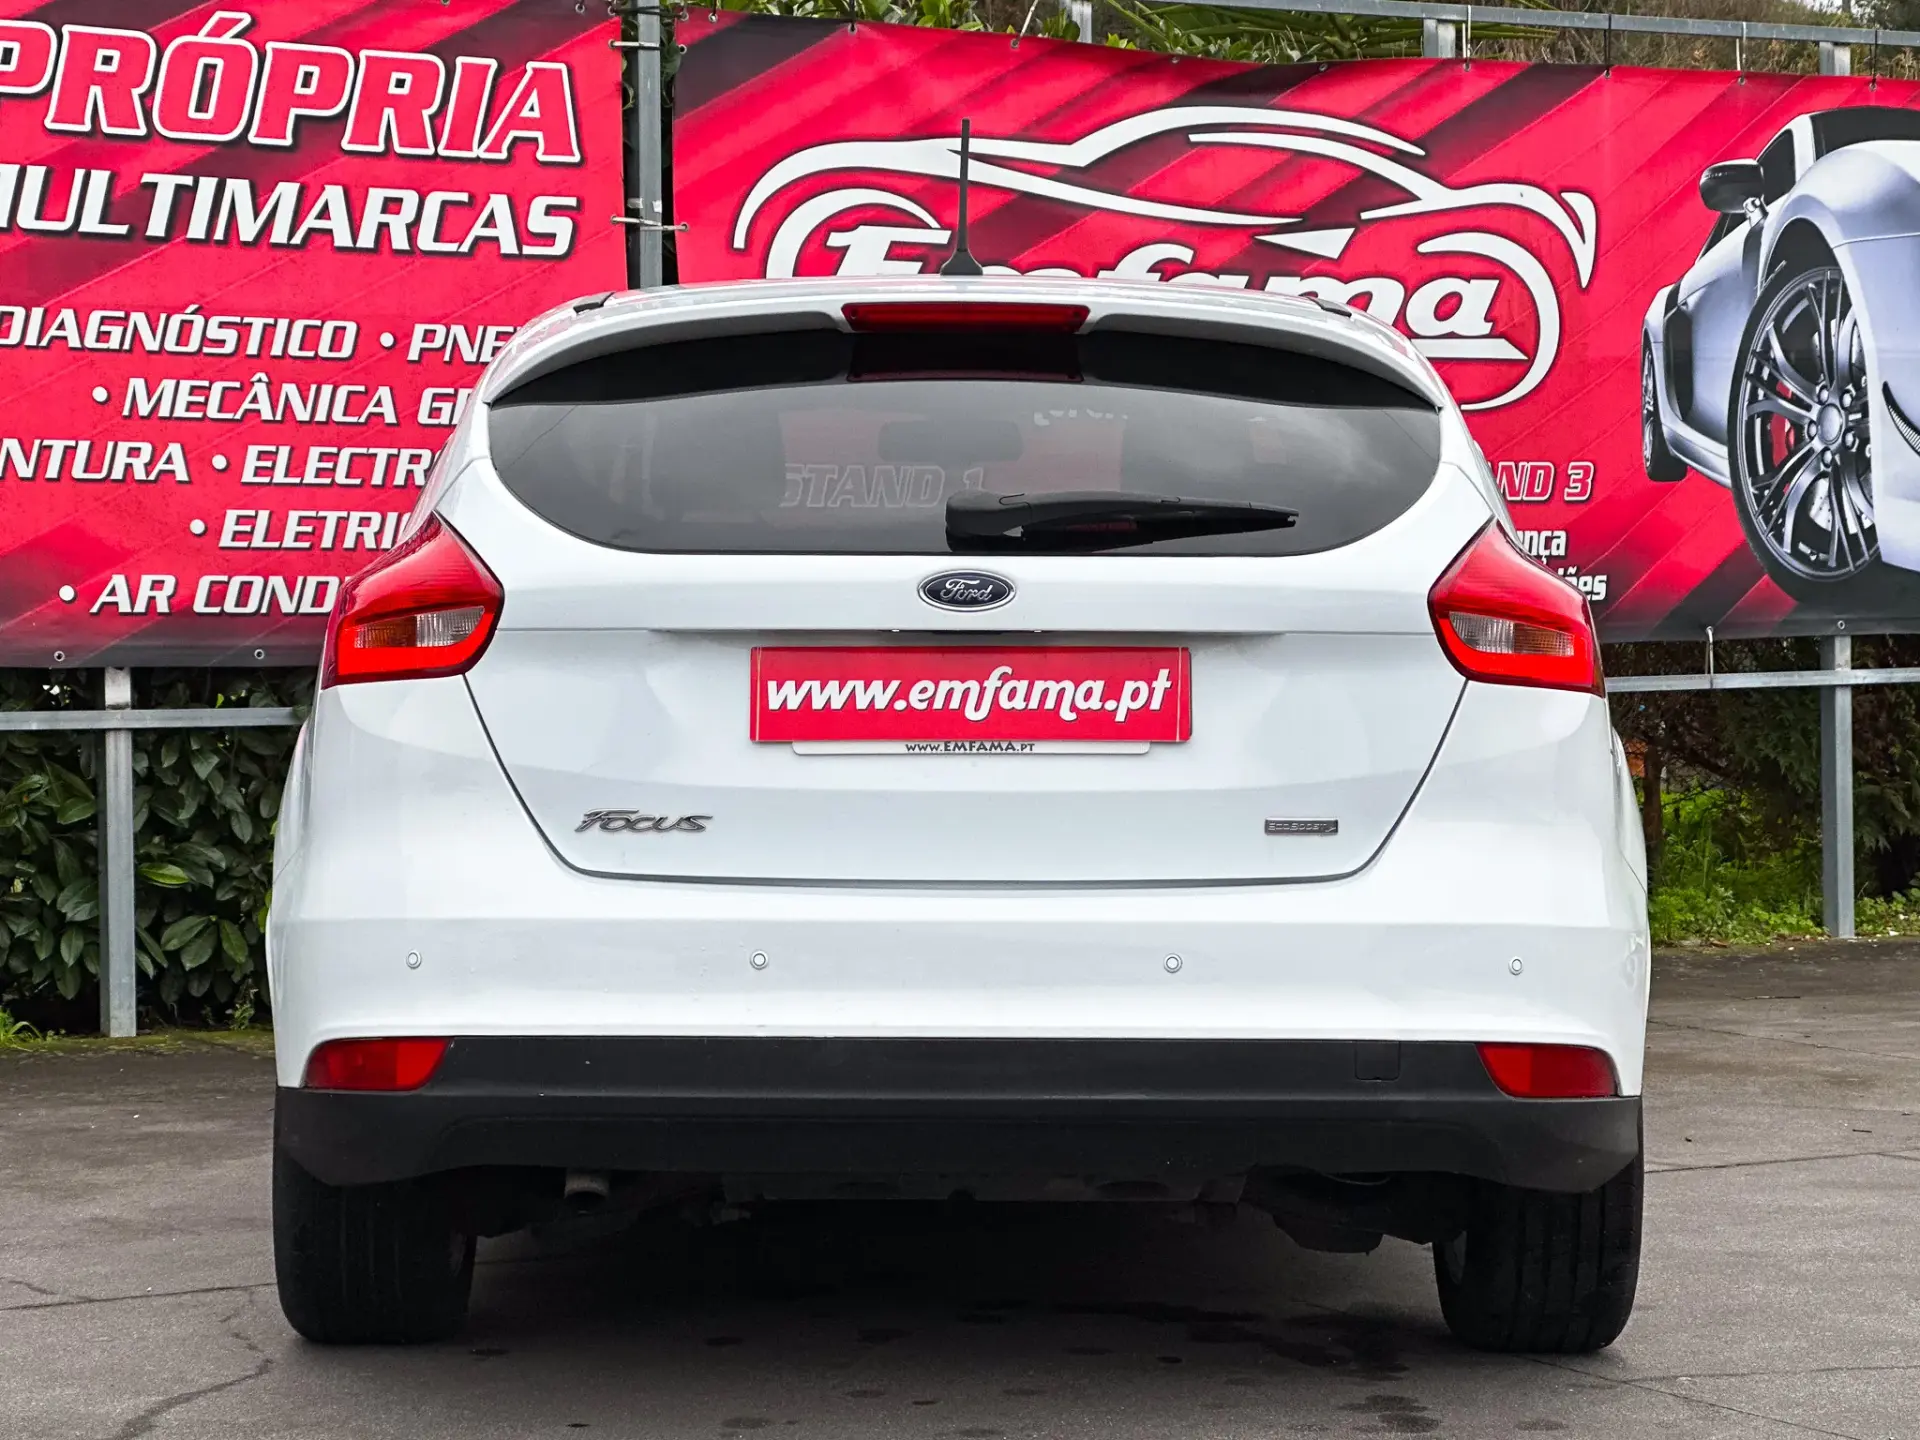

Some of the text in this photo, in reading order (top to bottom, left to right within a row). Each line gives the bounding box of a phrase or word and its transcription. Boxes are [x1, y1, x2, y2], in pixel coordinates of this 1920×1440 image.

[0, 163, 577, 257] ULTIMARCAS
[407, 323, 522, 362] PNE
[122, 371, 398, 424] MECÂNICA
[241, 444, 441, 486] ELECTR
[1489, 461, 1595, 501] ND 3
[90, 574, 350, 615] AR COND
[940, 578, 994, 601] Ford
[767, 666, 1171, 722] www.emfama.pt
